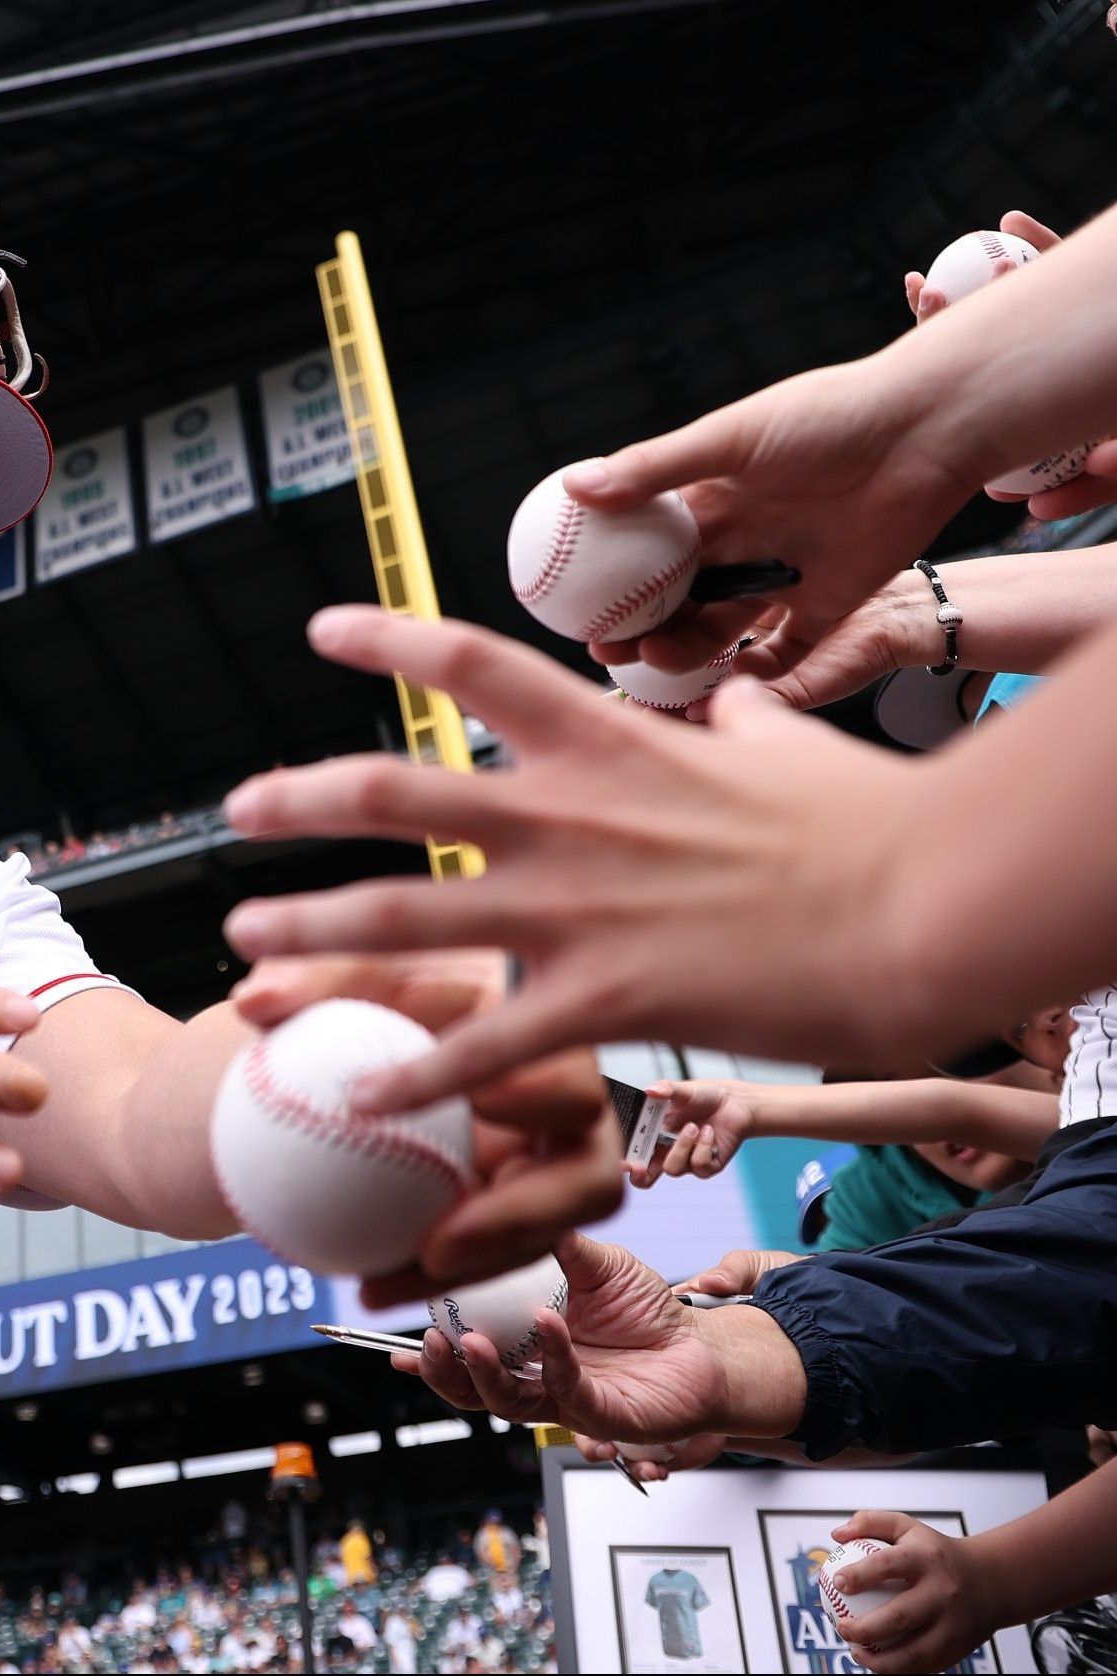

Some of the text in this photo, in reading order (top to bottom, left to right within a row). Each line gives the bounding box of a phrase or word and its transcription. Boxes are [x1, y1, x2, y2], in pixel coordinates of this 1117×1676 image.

[74, 1274, 207, 1361] DAY
[210, 1263, 316, 1326] 2023
[443, 1297, 474, 1336] Rawl
